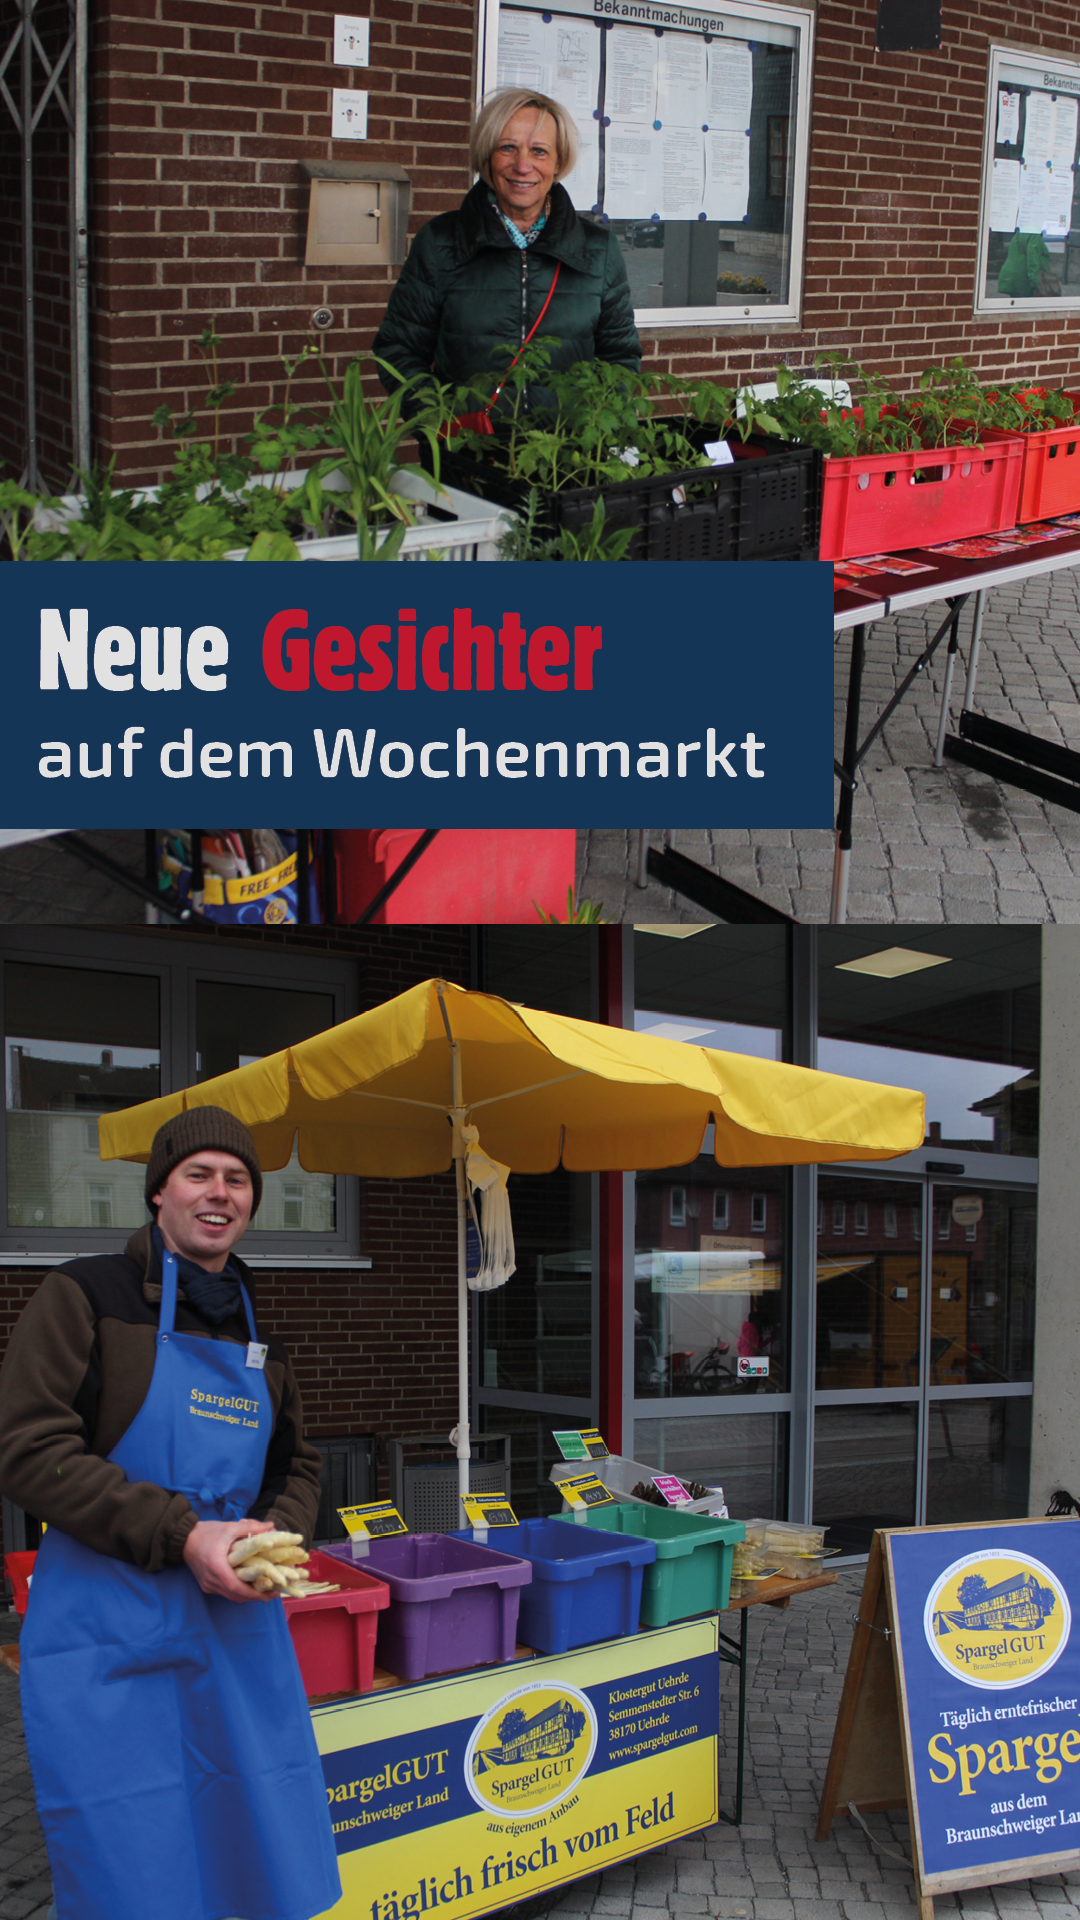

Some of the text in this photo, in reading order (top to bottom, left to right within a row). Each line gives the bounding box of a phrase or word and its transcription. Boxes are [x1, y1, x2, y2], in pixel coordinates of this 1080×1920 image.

[594, 0, 724, 32] Bekanntmachungen
[240, 861, 298, 898] FREE FRE
[189, 1405, 259, 1429] Braunschweiger Land
[190, 1388, 260, 1413] SpargelGUT
[973, 1656, 1034, 1671] Braunschweiger Land
[608, 1671, 690, 1705] Klostergut Uehrde
[608, 1685, 700, 1723] Semmenstedter Str. 6
[608, 1712, 670, 1741] 38170 Uehrde
[940, 1696, 1078, 1730] Täglich erntefrischer
[608, 1724, 699, 1761] www.spargelgut.com
[928, 1713, 1080, 1796] Sparge
[326, 1749, 449, 1805] argelGUT
[506, 1780, 562, 1803] Braunschweiger Land
[331, 1786, 450, 1834] unschweiger Land
[486, 1794, 580, 1838] aus eigenem Anbau
[990, 1793, 1048, 1815] aus dem
[945, 1809, 1080, 1845] Braunschweiger La
[369, 1791, 676, 1920] täglich frisch vom Feld
